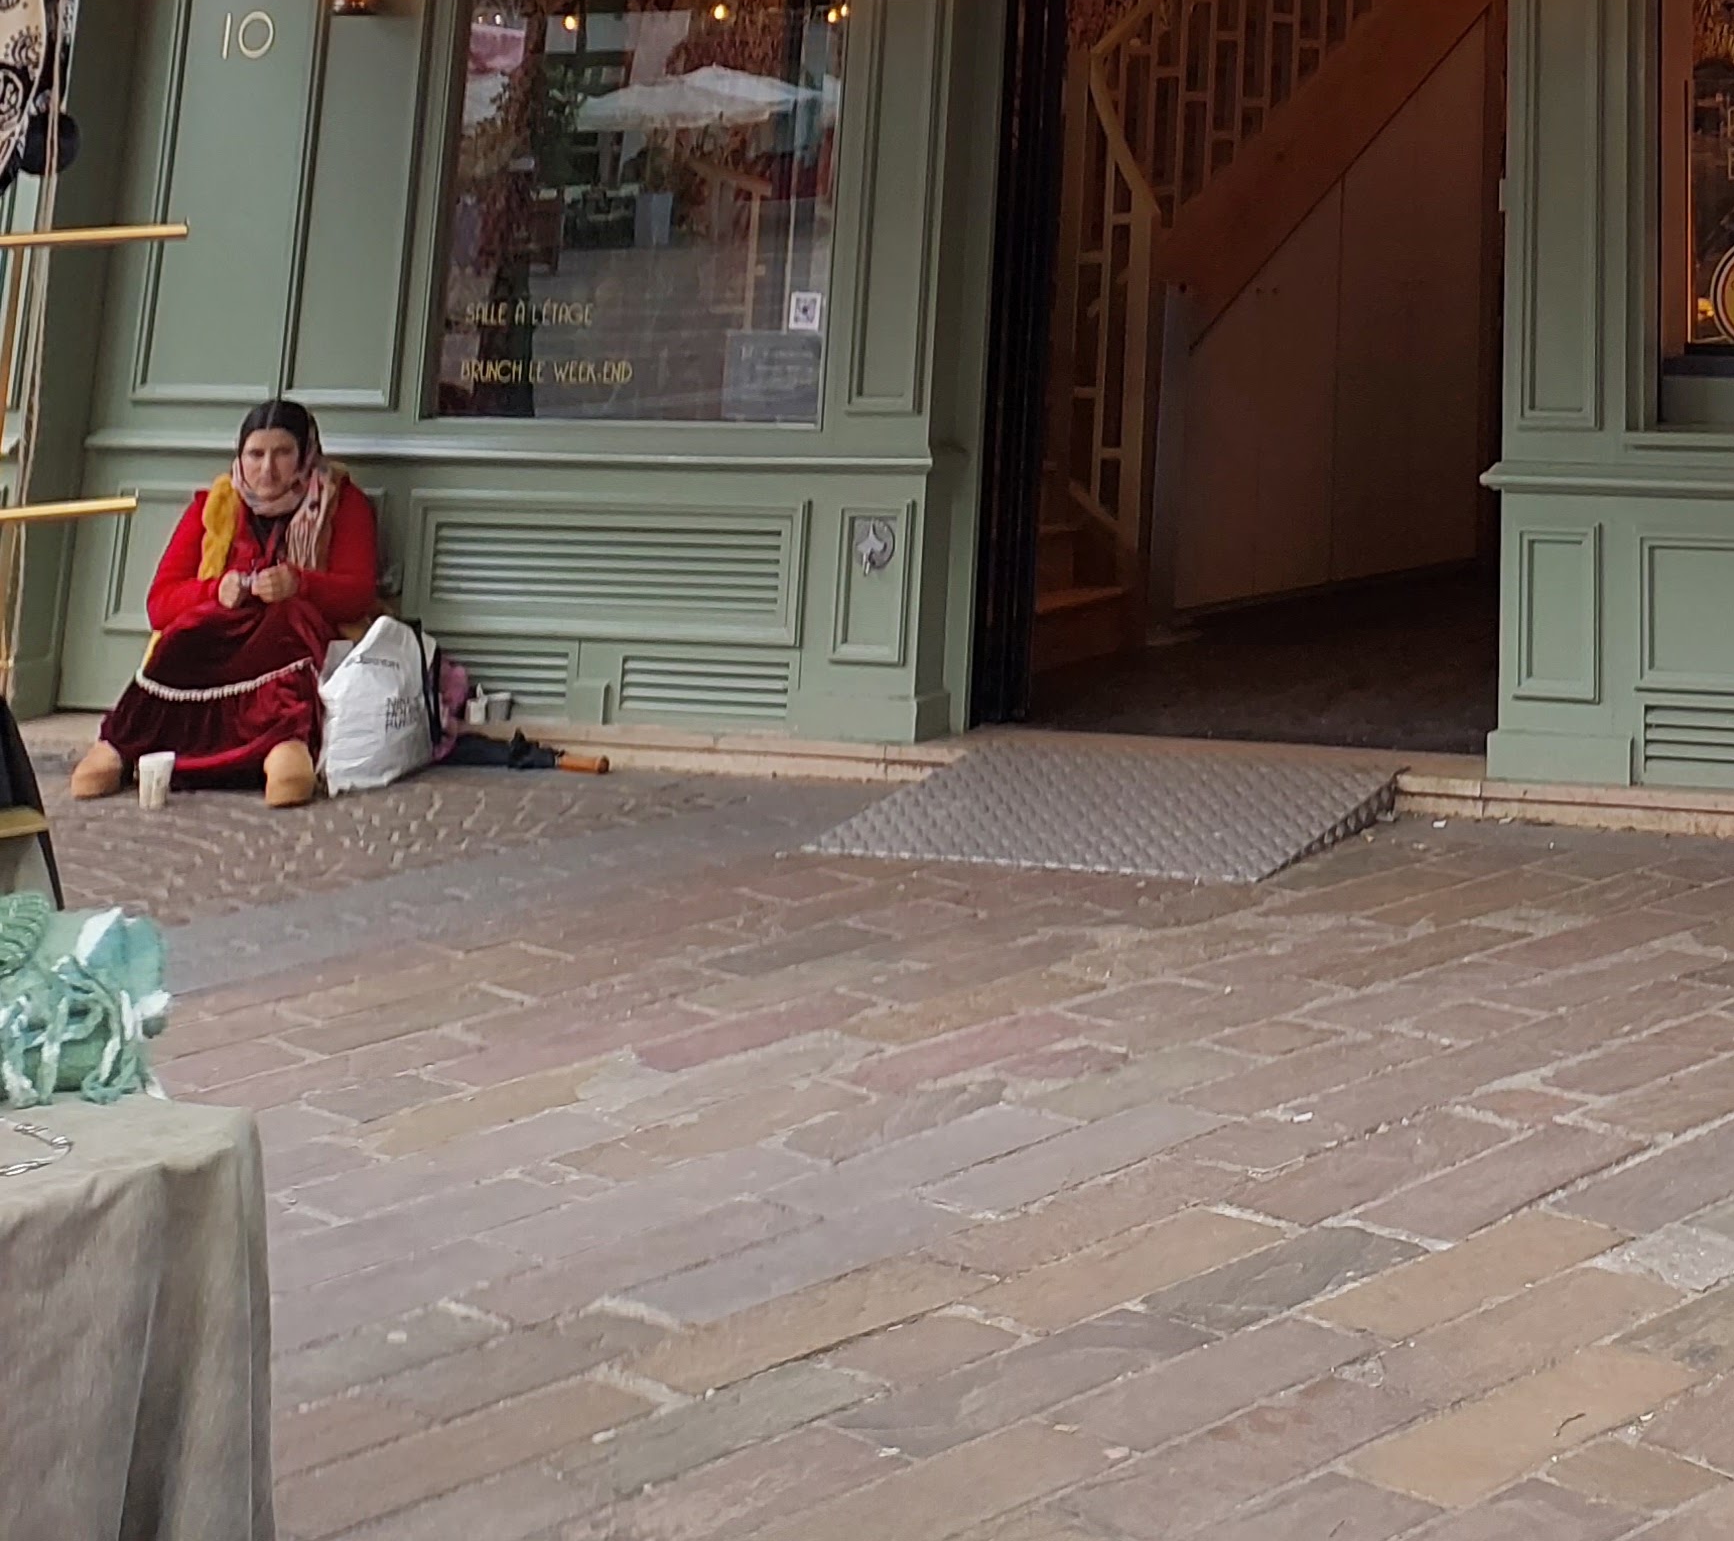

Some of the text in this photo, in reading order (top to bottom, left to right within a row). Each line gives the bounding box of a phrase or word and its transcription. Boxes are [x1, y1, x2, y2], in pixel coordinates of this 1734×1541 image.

[222, 10, 274, 60] 10
[465, 301, 508, 326] SALLE
[531, 297, 593, 326] L'ÉTAGE
[460, 359, 633, 384] BRUNCH LE WEEK-END
